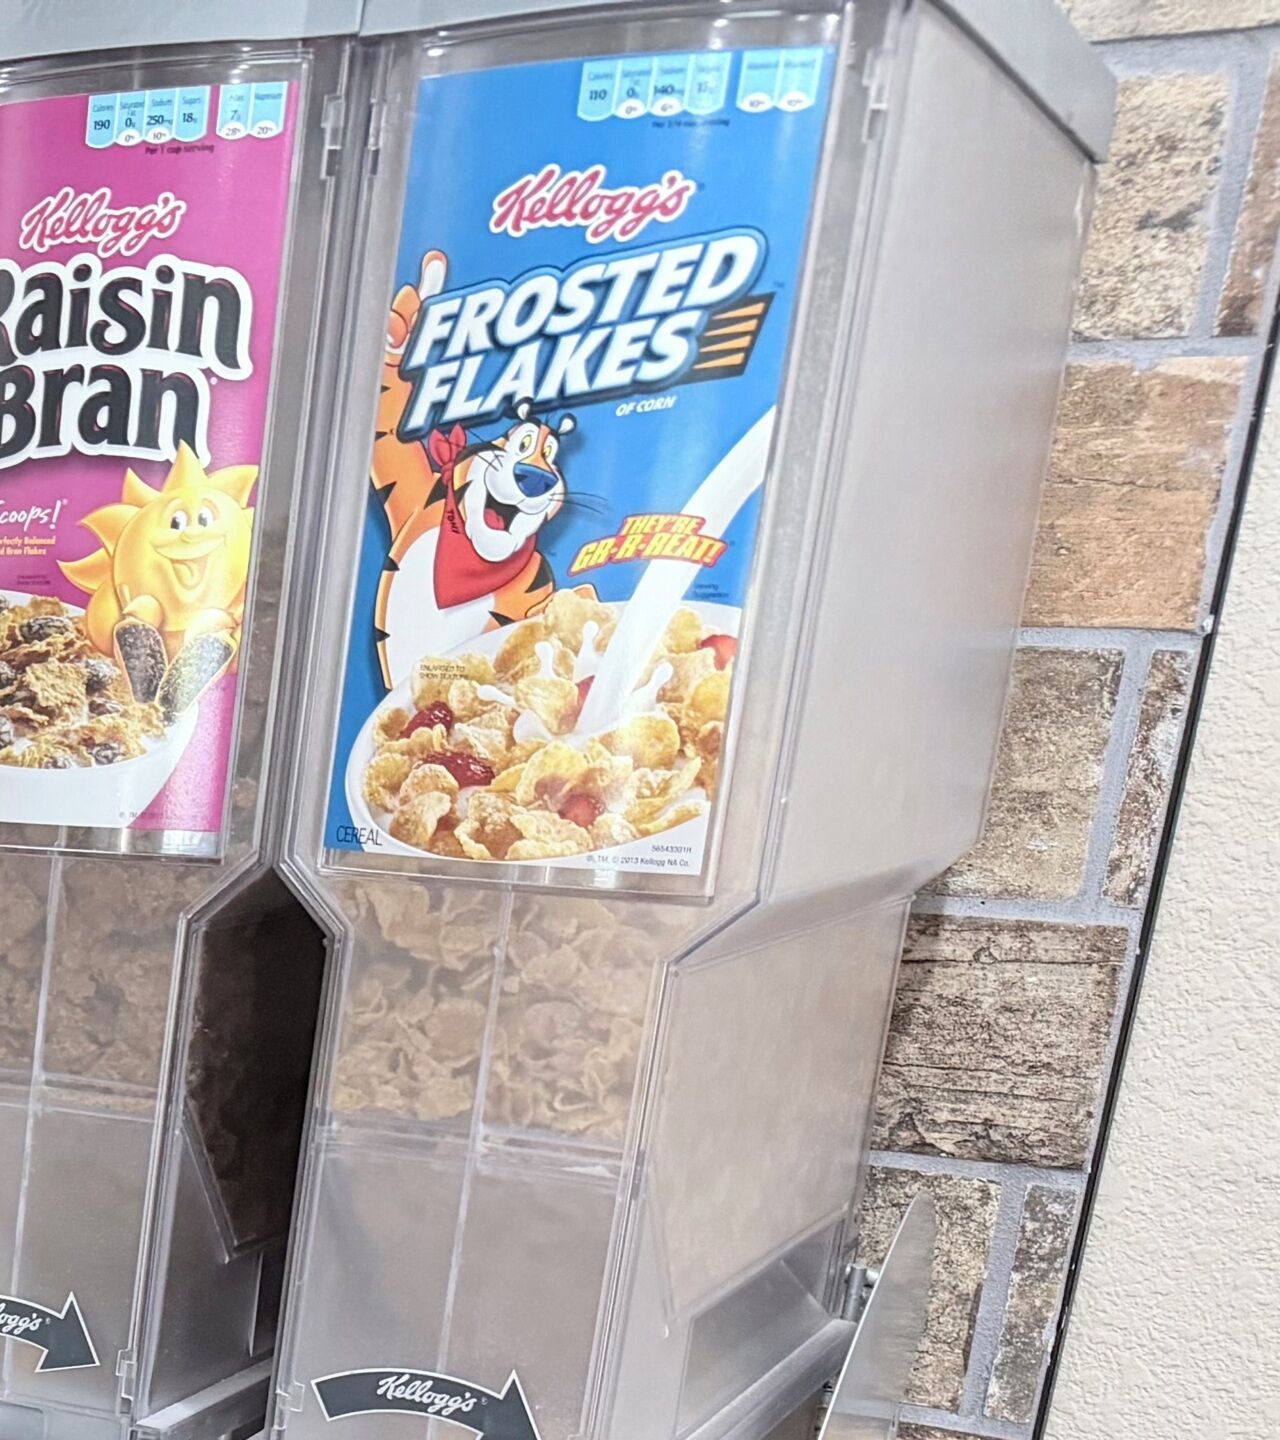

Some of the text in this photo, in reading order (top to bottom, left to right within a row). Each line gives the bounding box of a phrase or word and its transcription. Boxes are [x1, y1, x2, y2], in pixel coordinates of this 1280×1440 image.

[93, 119, 111, 131] 190
[22, 190, 186, 254] Kellogg's
[493, 167, 694, 241] Kellogg's
[406, 233, 760, 372] FROSTED
[404, 314, 702, 434] FLAKES
[615, 394, 678, 417] OF CORN
[445, 508, 461, 535] TONY
[335, 824, 383, 848] CEREAL
[376, 1375, 478, 1412] Kellogg's
